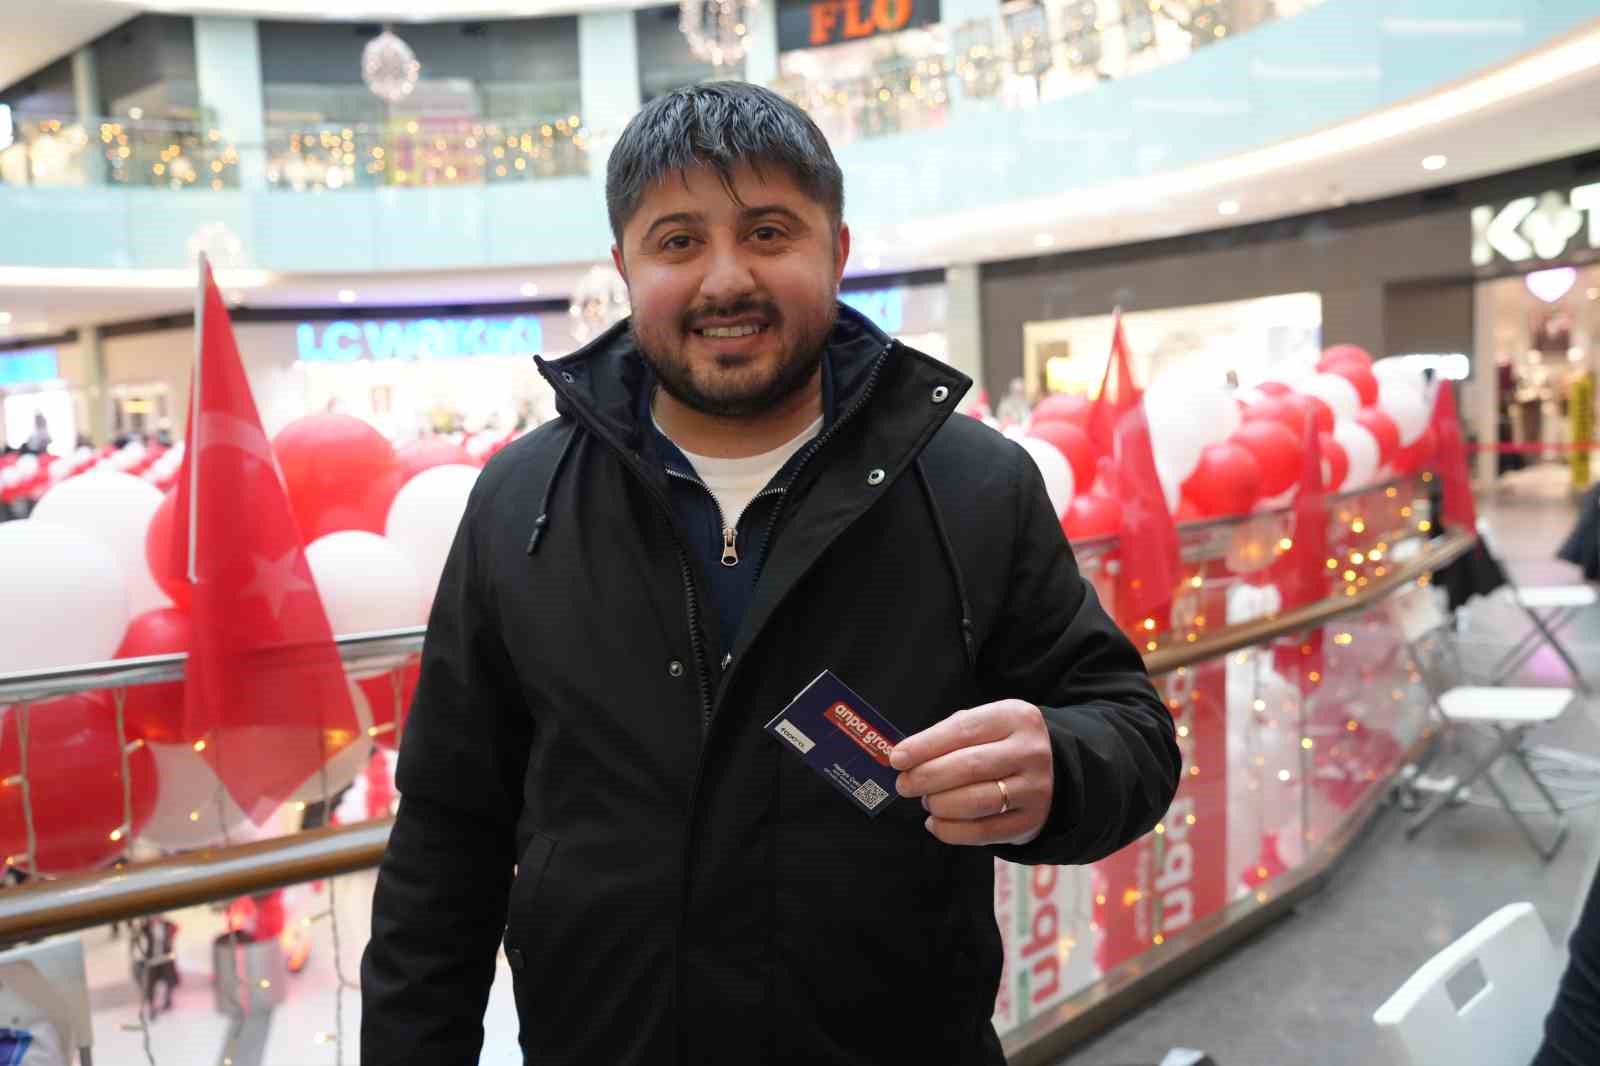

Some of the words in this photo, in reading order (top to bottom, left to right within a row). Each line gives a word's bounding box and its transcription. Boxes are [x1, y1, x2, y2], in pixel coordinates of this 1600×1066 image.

[808, 0, 911, 41] FLO
[297, 320, 362, 361] LC
[835, 704, 868, 734] anpa
[863, 730, 894, 756] gros
